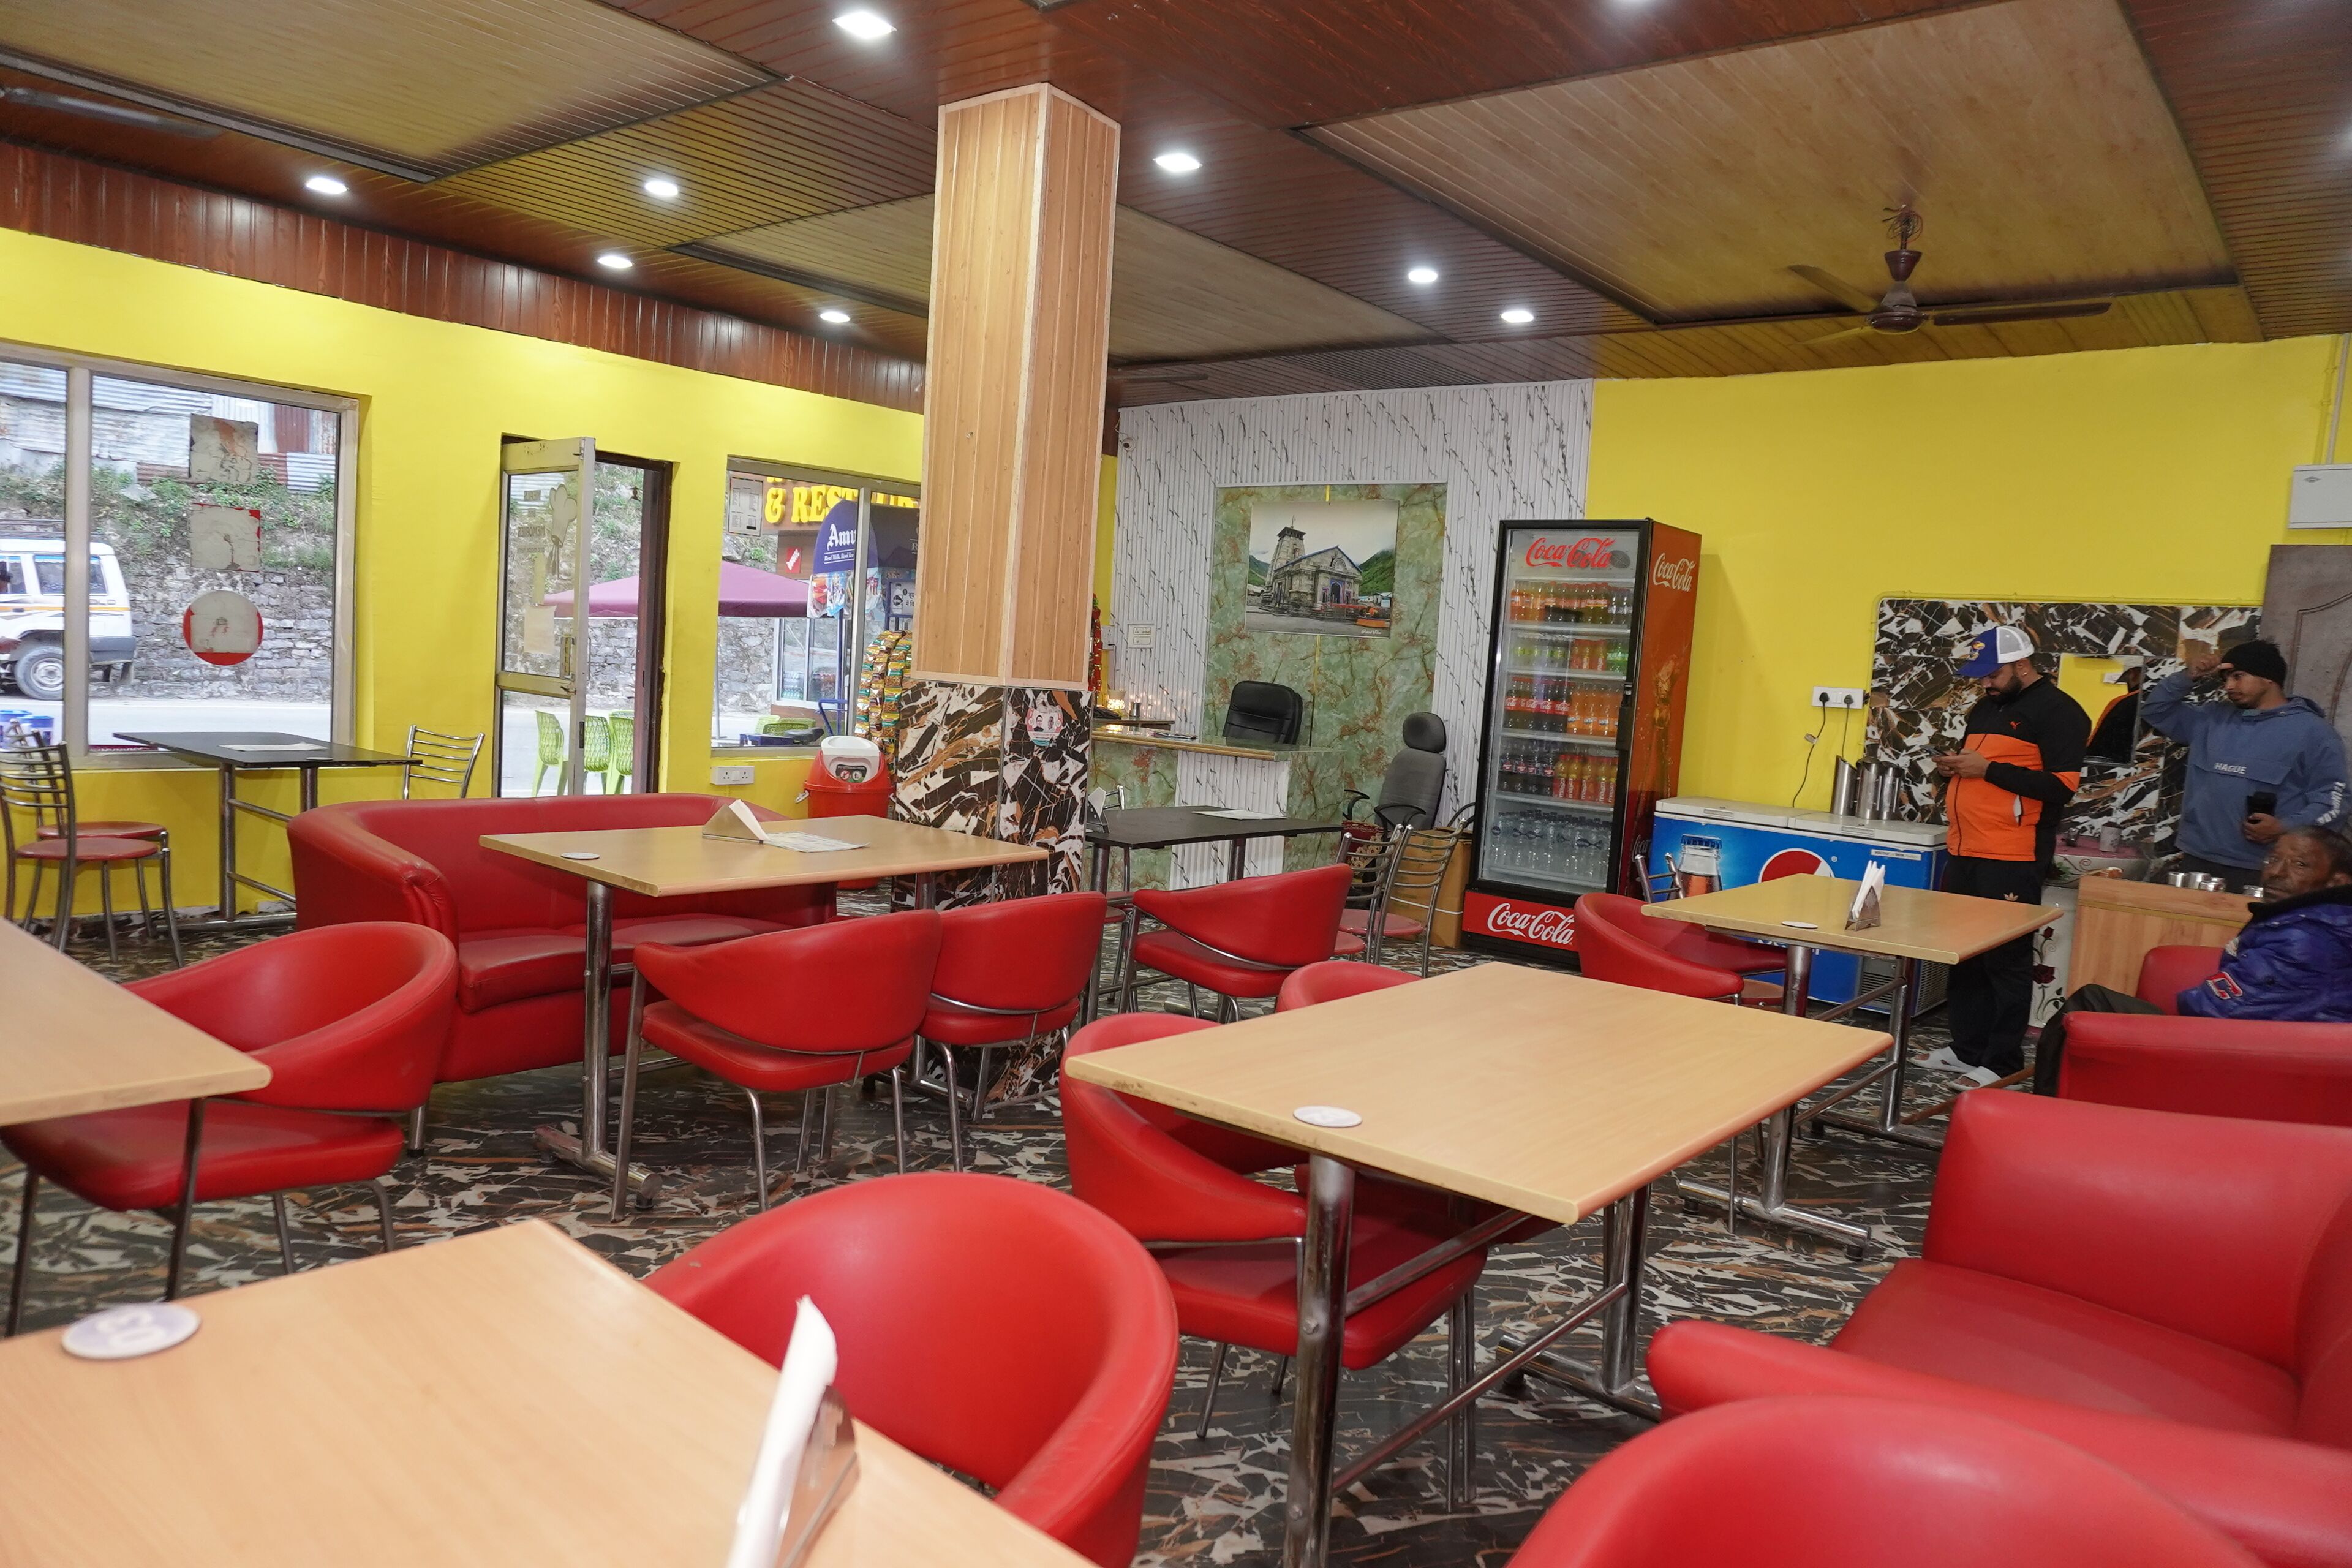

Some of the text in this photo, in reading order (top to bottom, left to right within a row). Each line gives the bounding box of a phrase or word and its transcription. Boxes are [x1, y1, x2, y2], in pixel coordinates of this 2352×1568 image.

[765, 487, 786, 524] &
[1525, 537, 1616, 568] Coca-Cola
[1653, 552, 1696, 592] Coca-Cola
[2214, 762, 2247, 774] HAGUE
[1487, 903, 1575, 944] Coca-Cola
